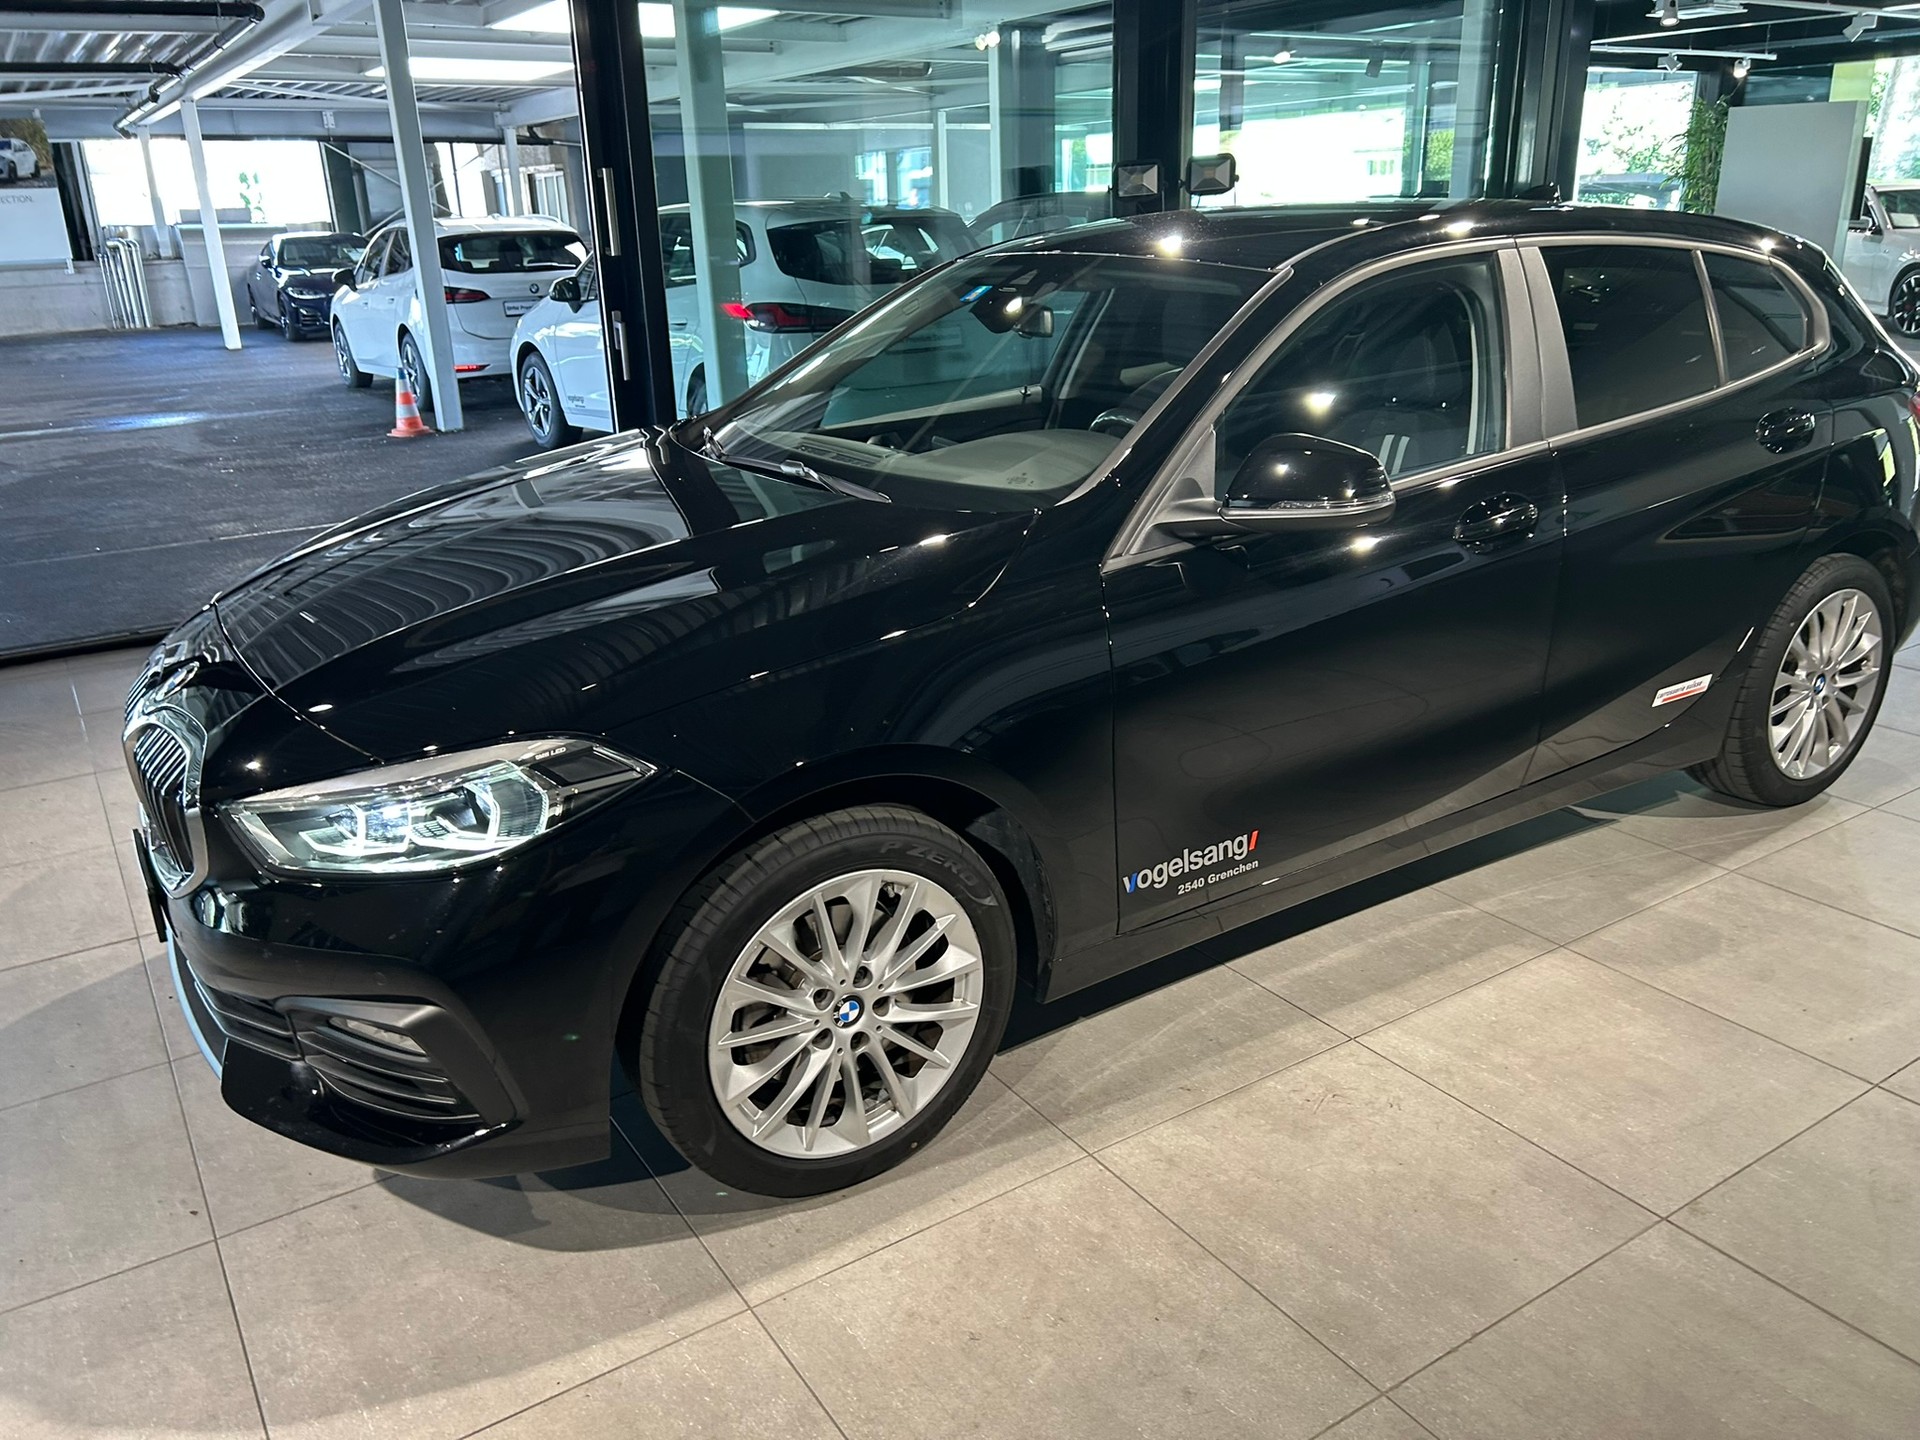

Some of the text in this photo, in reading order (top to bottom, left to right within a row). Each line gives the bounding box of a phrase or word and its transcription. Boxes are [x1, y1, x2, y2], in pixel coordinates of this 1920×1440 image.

[550, 746, 567, 756] LED
[880, 841, 979, 887] P ZERO
[1177, 860, 1259, 896] 2540 Grenchen
